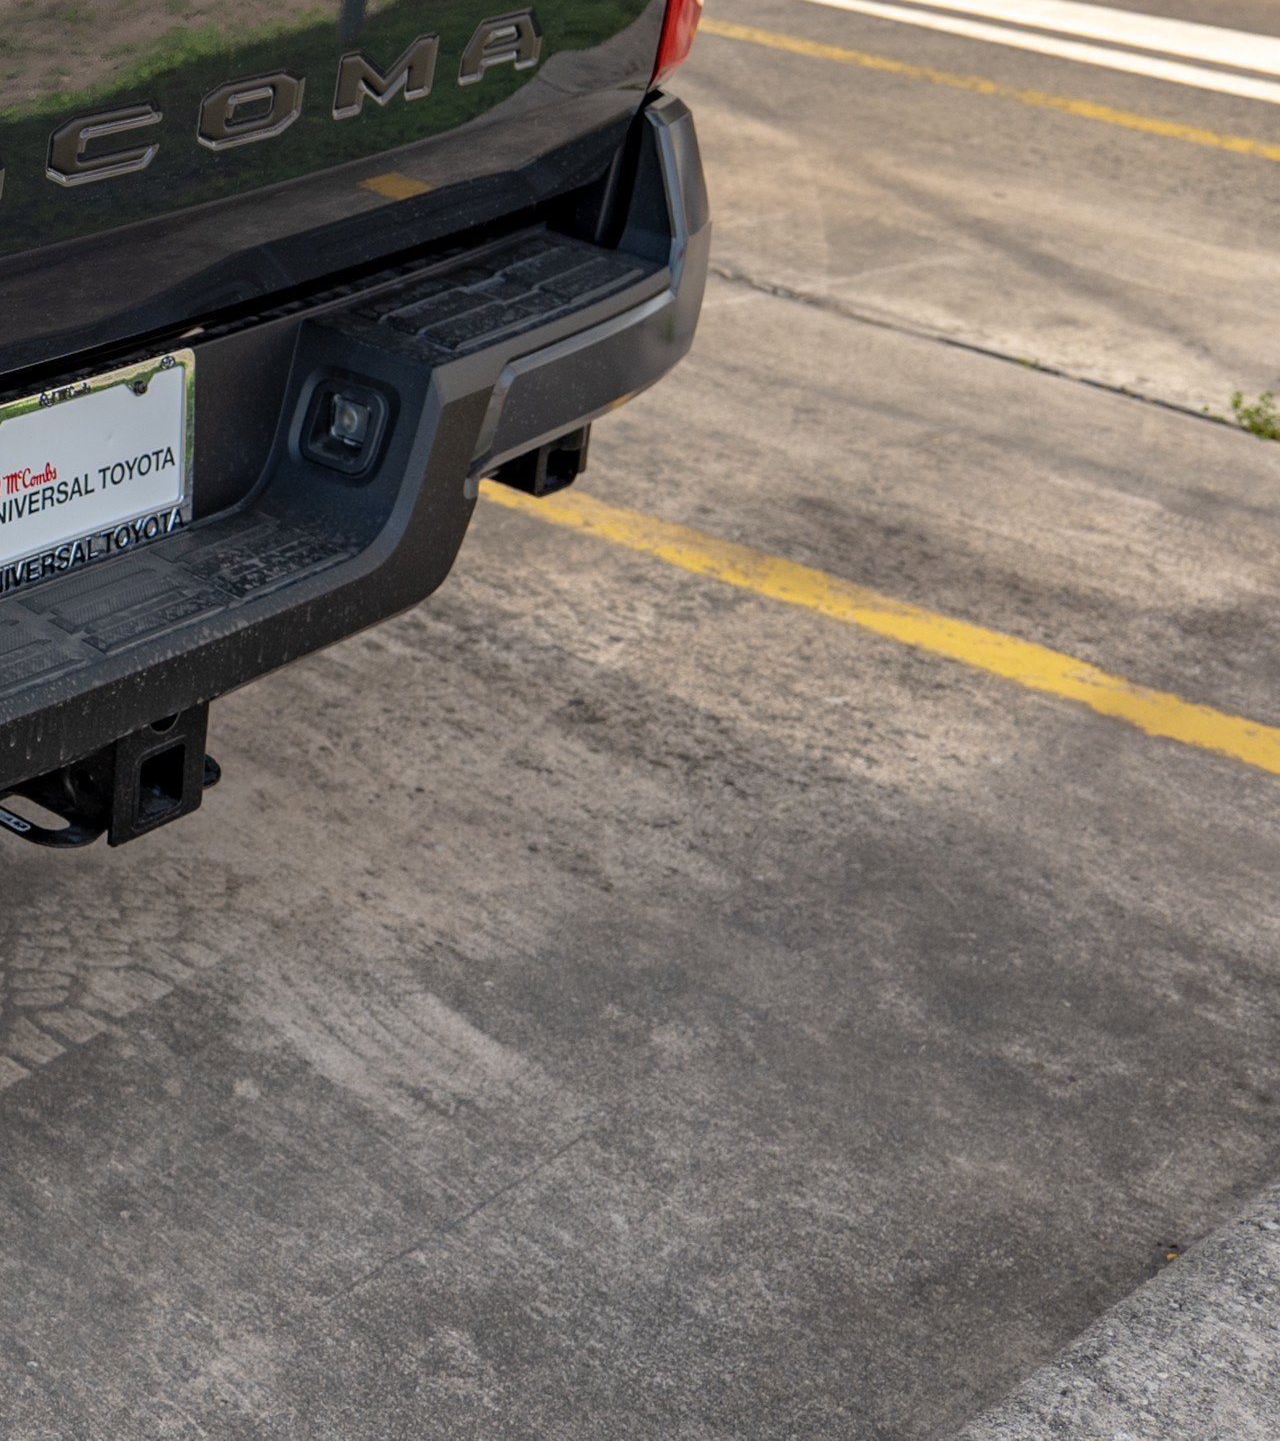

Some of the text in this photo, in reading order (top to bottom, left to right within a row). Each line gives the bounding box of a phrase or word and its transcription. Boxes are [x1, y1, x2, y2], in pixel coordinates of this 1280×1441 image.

[2, 462, 58, 495] McCombs
[98, 446, 176, 490] TOYOTA
[100, 507, 185, 554] TOYOTA
